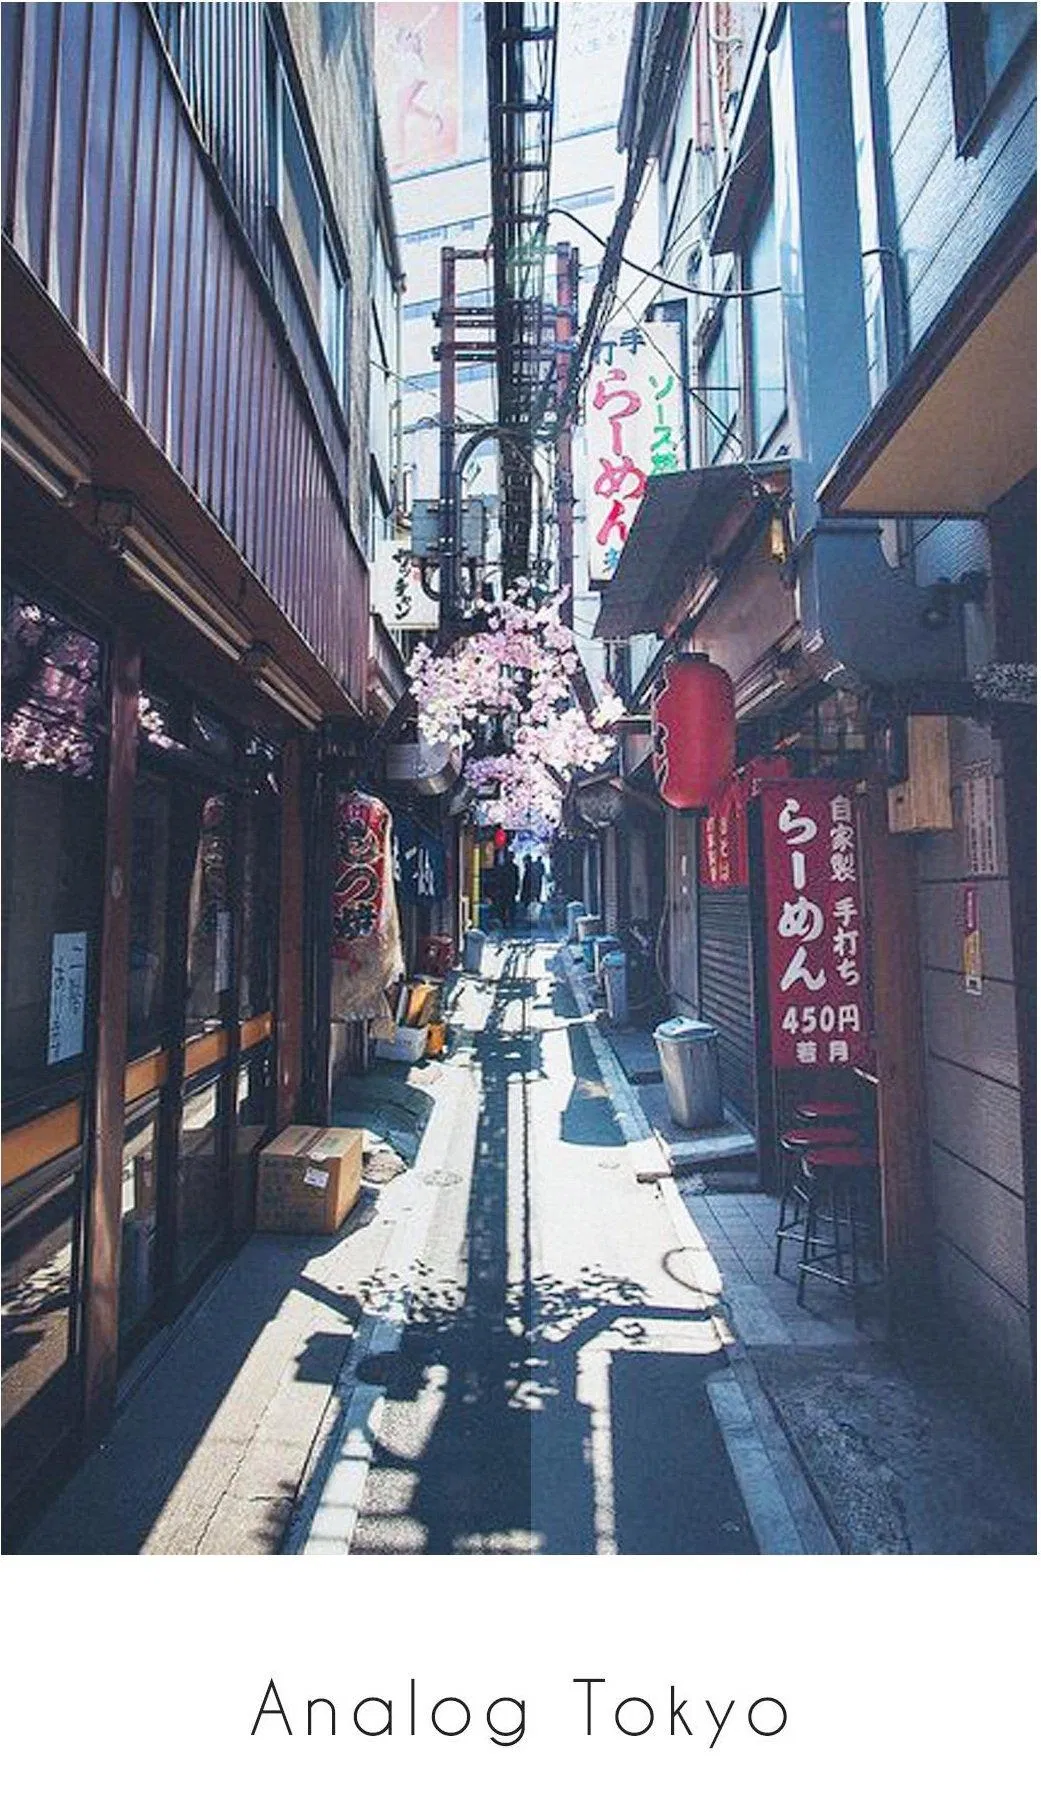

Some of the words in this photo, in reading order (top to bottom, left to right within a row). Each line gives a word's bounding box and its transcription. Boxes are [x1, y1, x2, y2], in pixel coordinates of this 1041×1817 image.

[593, 368, 648, 547] らーめん
[829, 794, 857, 883] 自家製
[777, 797, 827, 992] らーめん
[832, 896, 862, 987] 手打ち
[780, 1003, 862, 1035] 450円
